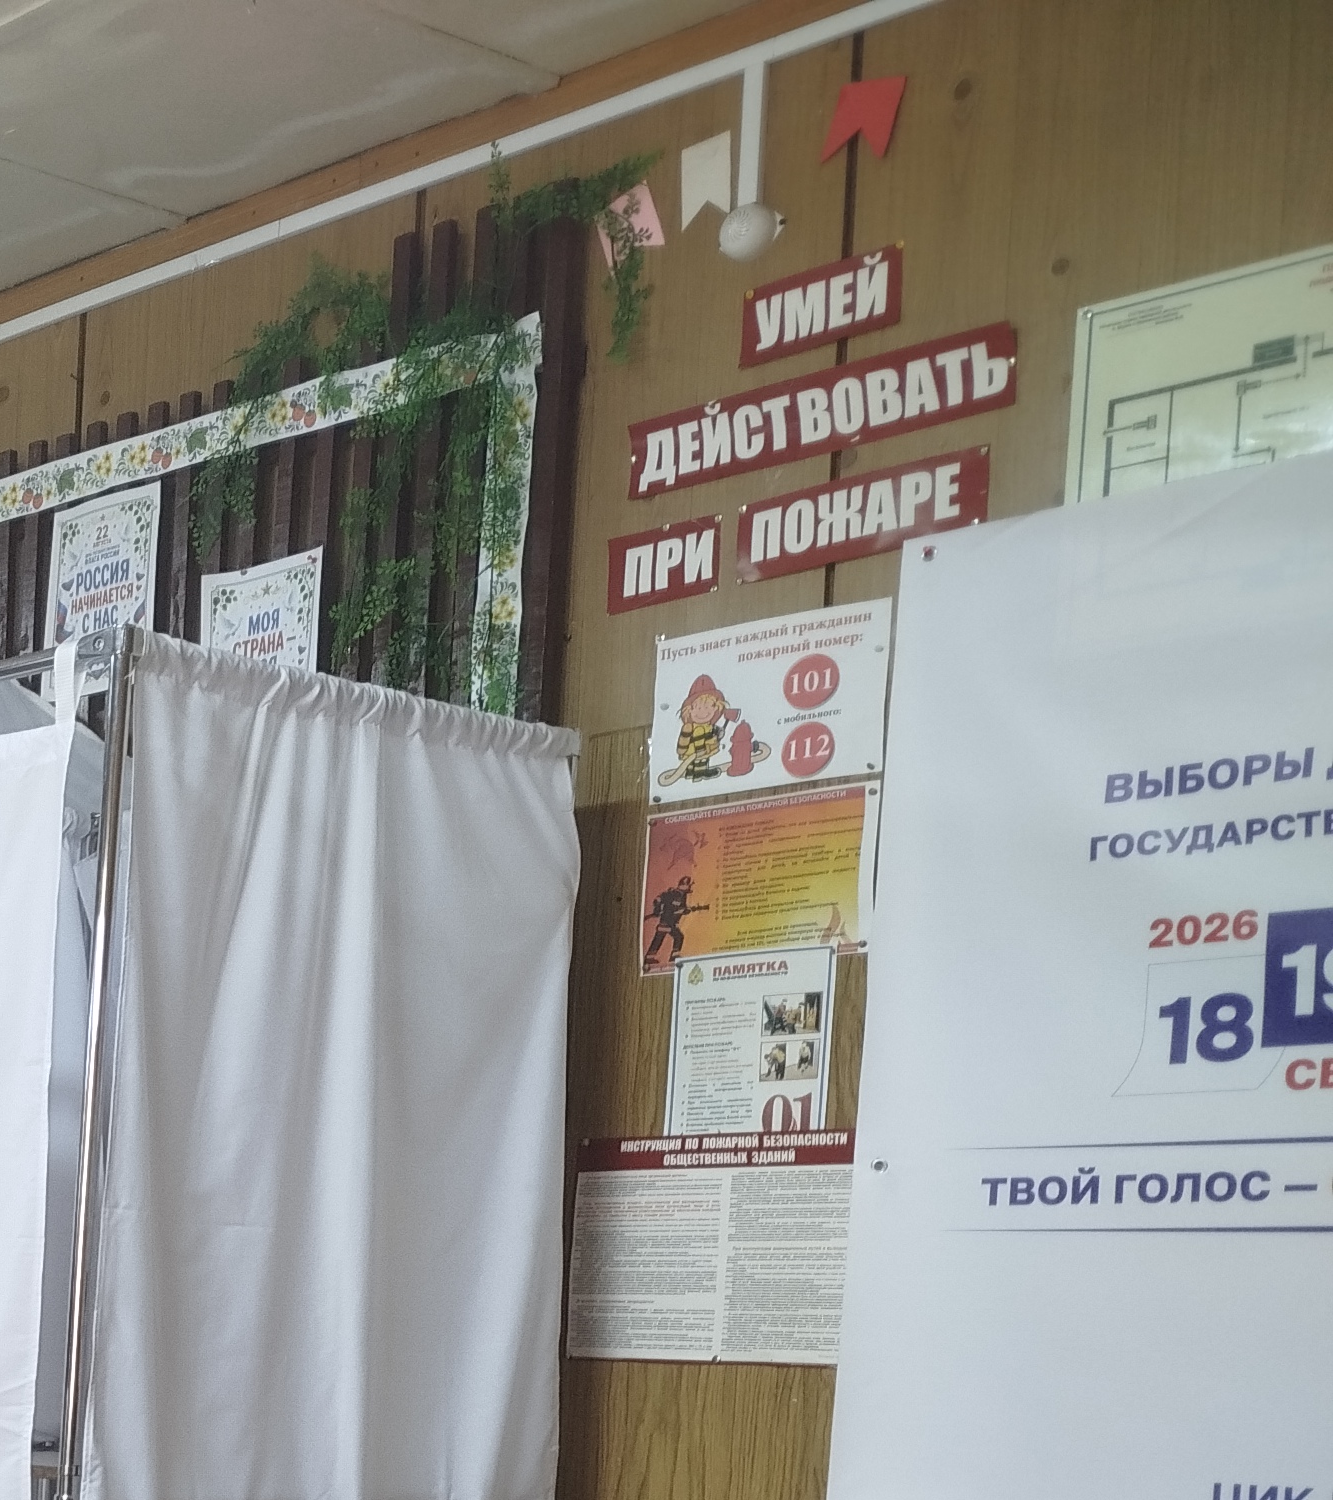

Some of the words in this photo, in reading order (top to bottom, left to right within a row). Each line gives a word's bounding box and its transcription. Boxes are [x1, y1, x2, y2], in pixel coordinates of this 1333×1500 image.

[755, 252, 889, 352] УМЕЙ
[637, 342, 1009, 493] ДЕЙСТВОВАТЬ
[96, 524, 109, 540] 22
[622, 528, 715, 598] ПРИ
[750, 462, 961, 564] ПОЖАРЕ
[76, 558, 130, 596] РОССИЯ
[71, 582, 134, 615] НАЧИНАЕТСЯ
[82, 613, 90, 633] С
[93, 604, 119, 631] НАС
[247, 607, 281, 636] МОЯ
[233, 630, 284, 659] СТРАНА
[660, 643, 697, 662] Пусть
[699, 637, 731, 653] знает
[735, 623, 789, 646] каждый
[792, 612, 873, 636] гражданин
[737, 636, 810, 663] пожарный
[814, 632, 864, 649] номер:
[789, 667, 832, 696] 101
[783, 708, 842, 725] мобильного:
[787, 734, 831, 762] 112
[1104, 747, 1315, 804] ВЫБОРЫ
[664, 810, 712, 825] СОБЛЮДАЙТЕ
[712, 804, 746, 817] ПРАВИЛА
[746, 798, 789, 812] ПОЖАРНОЙ
[789, 789, 847, 805] БЕЗОПАСНОСТИ
[1148, 909, 1259, 949] 2026
[713, 960, 789, 977] ПАМЯТКА
[1158, 992, 1255, 1065] 18
[1281, 943, 1333, 1017] 1
[761, 1092, 813, 1132] 01
[620, 1137, 682, 1153] ИНСТРУКЦИЯ
[684, 1136, 699, 1150] ПО
[702, 1133, 759, 1149] ПОЖАРНОЙ
[763, 1132, 848, 1148] БЕЗОПАСНОСТИ
[663, 1150, 748, 1167] ОБЩЕСТВЕННЫХ
[751, 1148, 796, 1164] ЗДАНИЙ
[981, 1166, 1100, 1206] ТВОЙ
[1114, 1170, 1271, 1205] ГОЛОС
